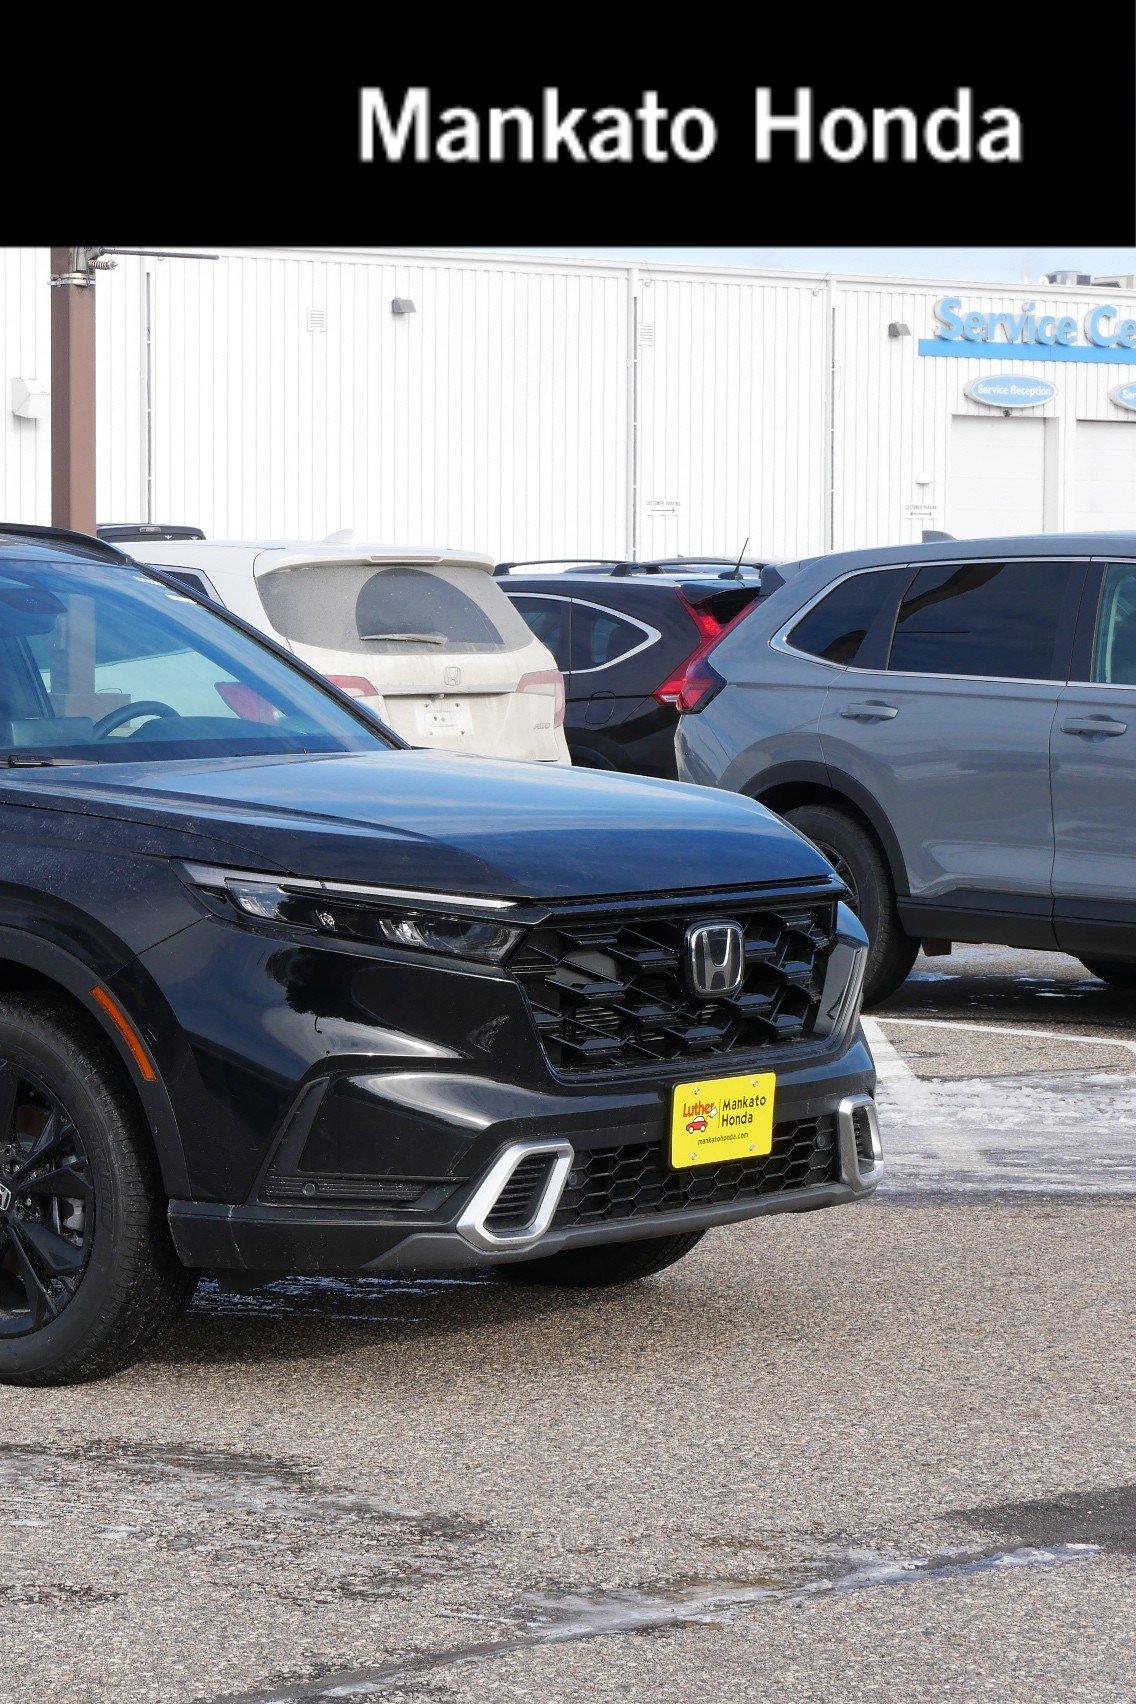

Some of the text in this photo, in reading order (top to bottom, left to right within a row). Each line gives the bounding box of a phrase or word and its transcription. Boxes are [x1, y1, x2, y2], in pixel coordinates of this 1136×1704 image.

[935, 297, 1078, 345] Service
[977, 384, 1052, 398] Service Reception
[682, 1101, 715, 1117] Luther
[722, 1095, 766, 1111] Mankato
[721, 1111, 753, 1127] Honda
[697, 1132, 749, 1145] mankatohonda.com
